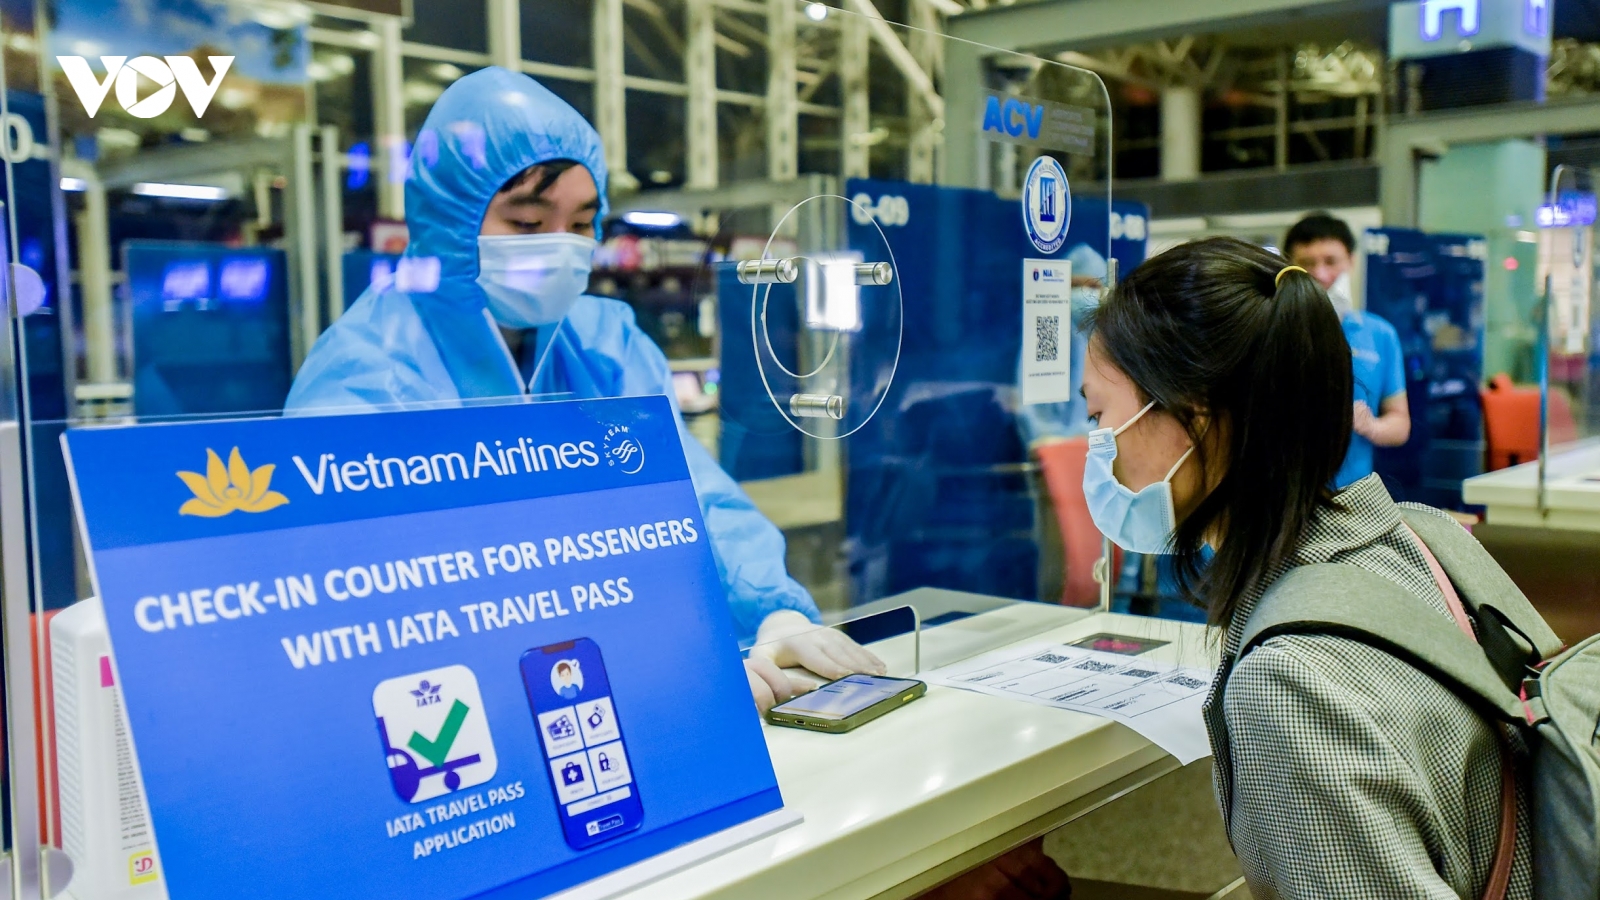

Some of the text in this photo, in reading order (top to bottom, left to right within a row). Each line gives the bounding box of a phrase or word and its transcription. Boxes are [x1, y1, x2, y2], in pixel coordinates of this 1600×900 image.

[983, 95, 1044, 139] ACV
[292, 437, 600, 495] Vietnam Airlines
[602, 425, 629, 467] SKYTEAM
[134, 518, 698, 633] CHECK-IN COUNTER FOR PASSENGERS
[281, 576, 634, 669] WITH IATA TRAVEL PASS
[416, 694, 442, 708] IATA
[385, 781, 525, 838] IATA TRAVEL PASS
[413, 811, 516, 860] APPLICATION
